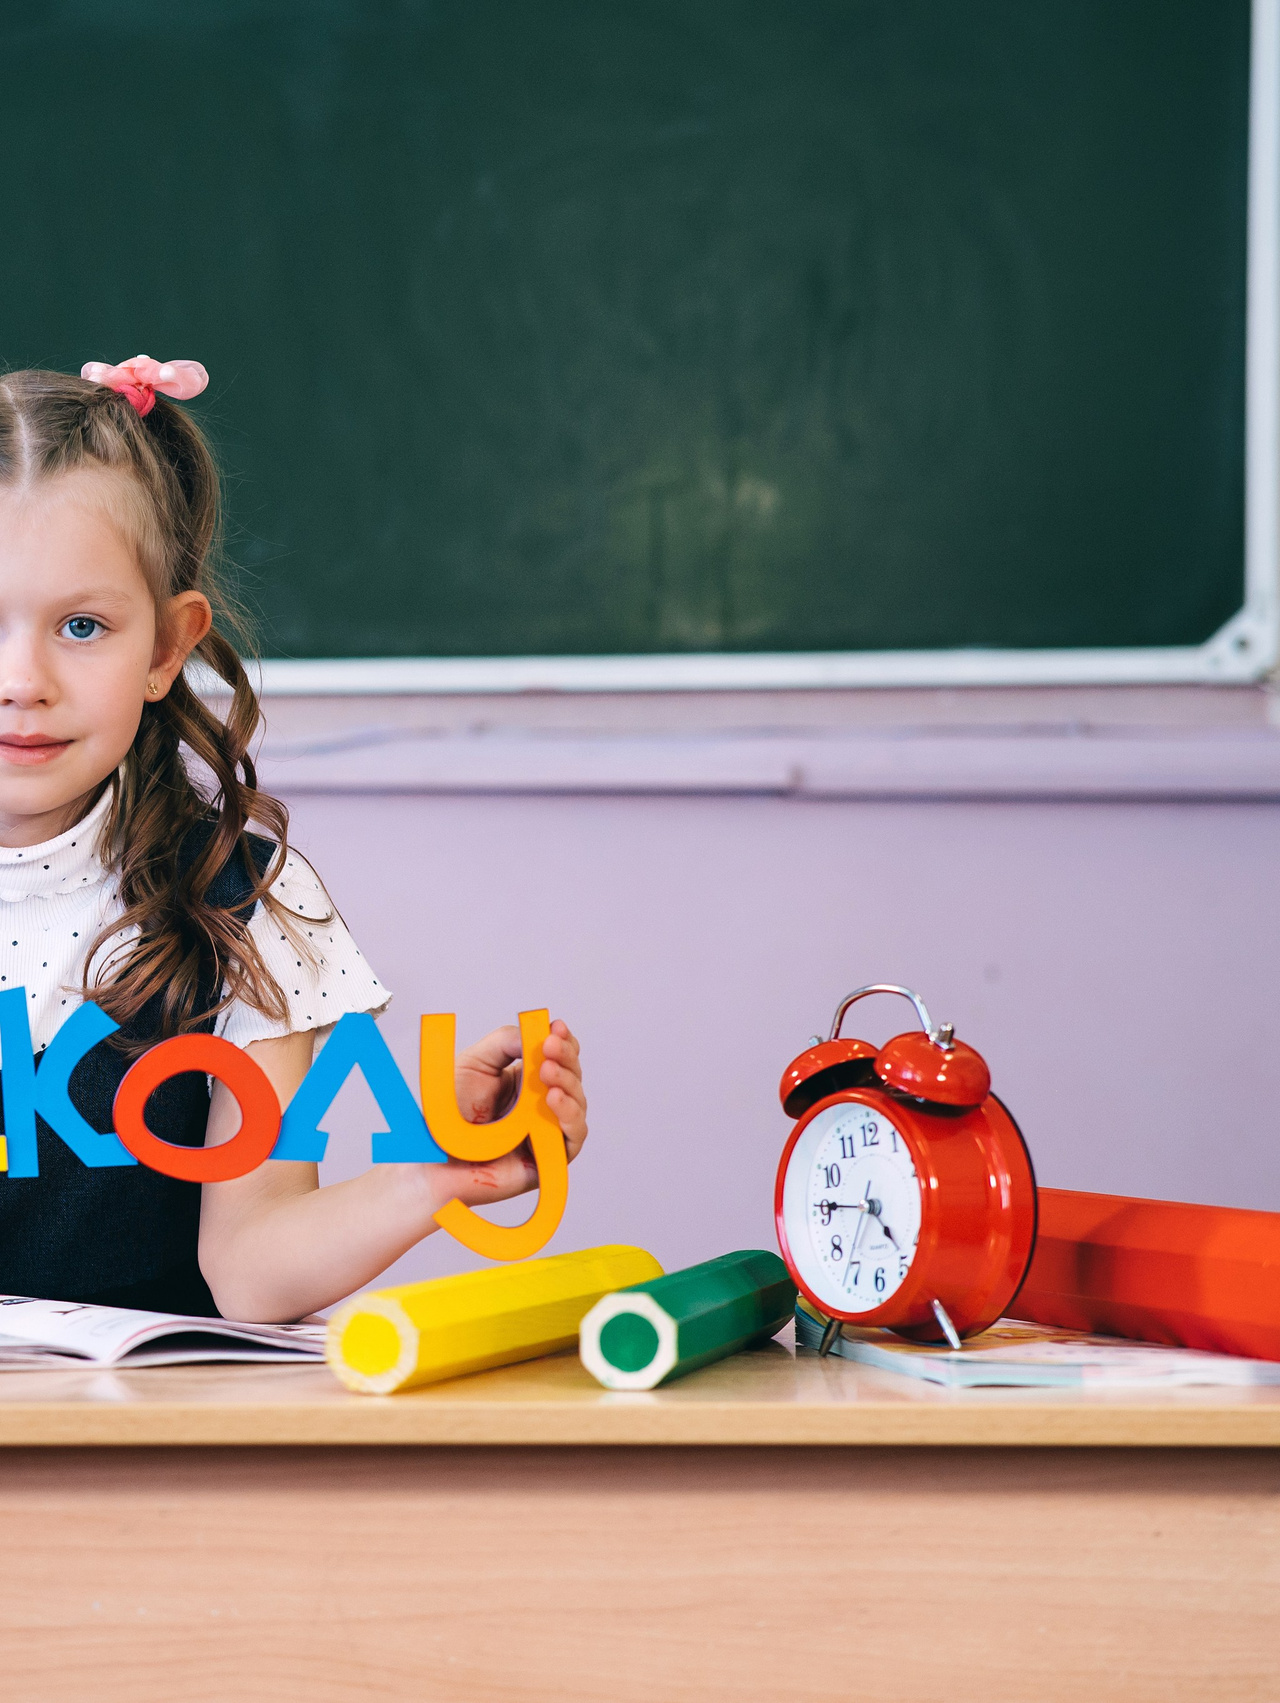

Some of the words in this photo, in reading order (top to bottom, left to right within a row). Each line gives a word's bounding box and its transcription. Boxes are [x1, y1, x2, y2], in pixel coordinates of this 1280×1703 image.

[839, 1134, 856, 1159] 11
[860, 1121, 880, 1147] 12
[890, 1130, 899, 1153] 1
[823, 1163, 841, 1189] 10
[820, 1198, 832, 1226] 9
[831, 1234, 843, 1262] 8
[850, 1261, 861, 1286] 7
[874, 1267, 886, 1292] 6
[899, 1255, 909, 1280] 5
